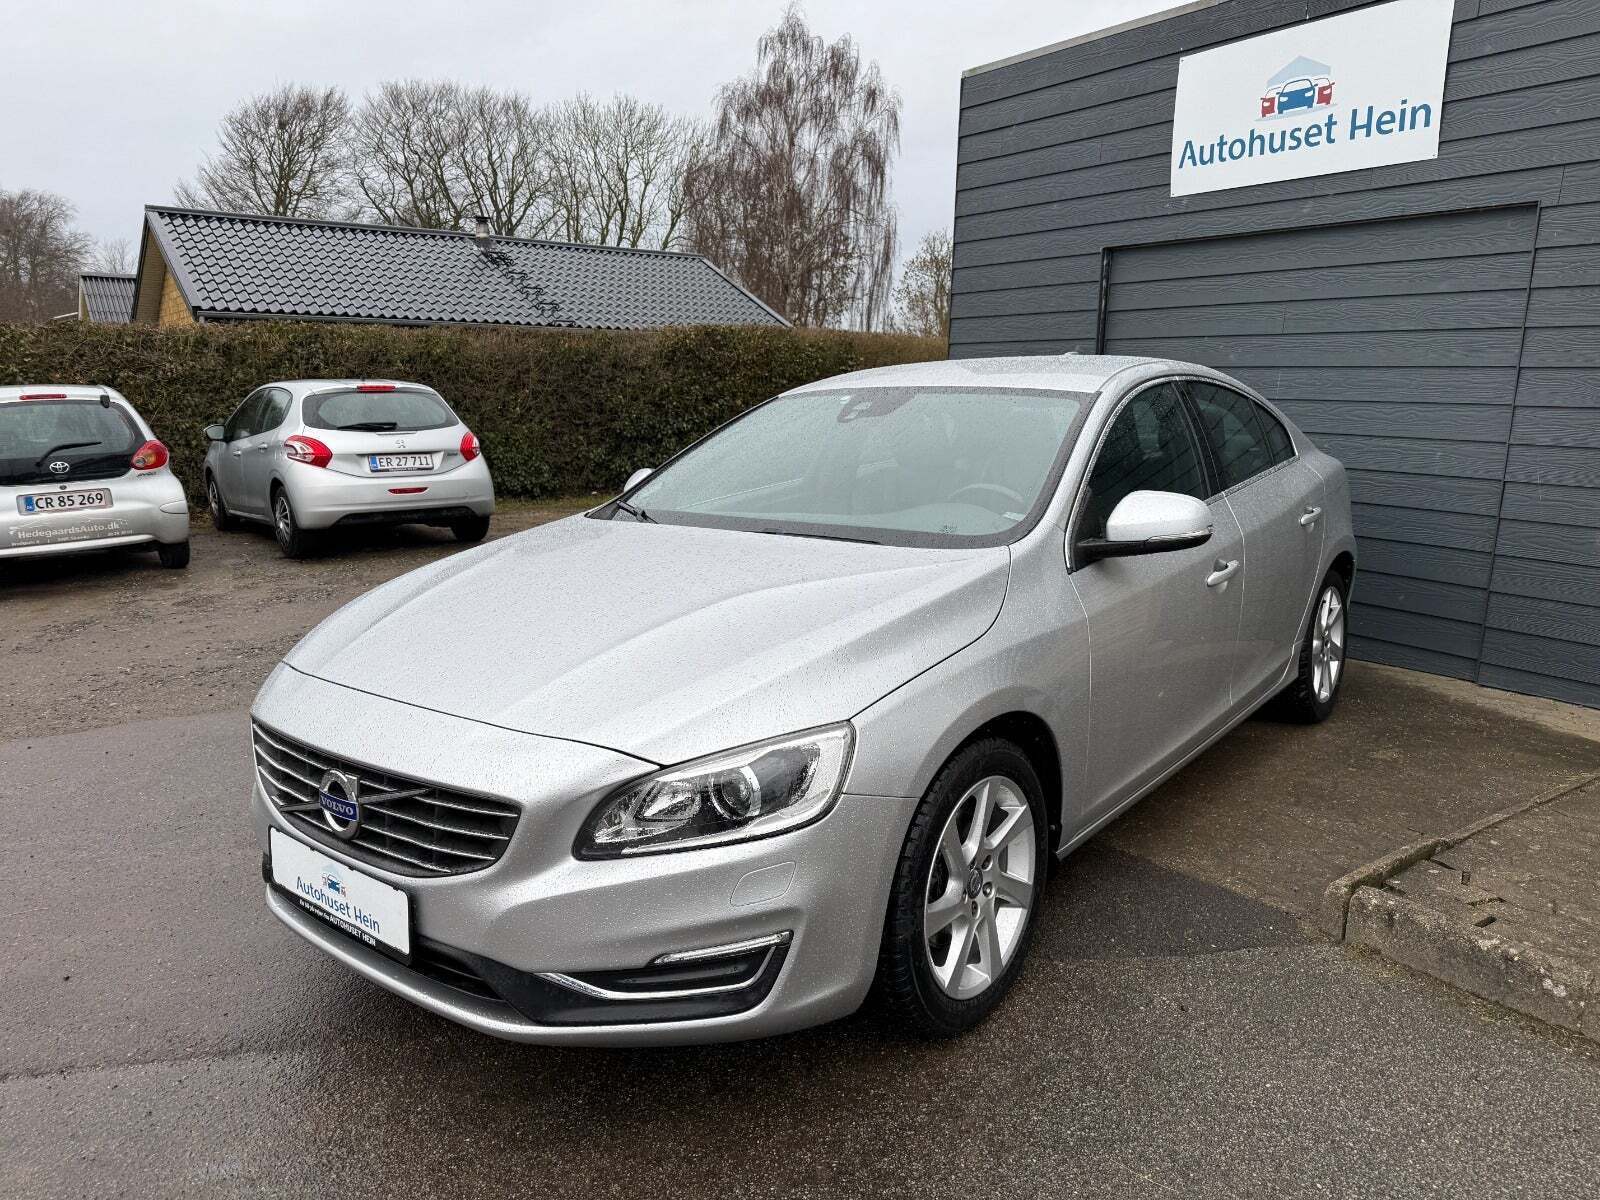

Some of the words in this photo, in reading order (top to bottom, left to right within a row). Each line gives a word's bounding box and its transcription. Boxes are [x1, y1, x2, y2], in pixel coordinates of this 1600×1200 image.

[1178, 113, 1338, 169] Autohuset
[1349, 98, 1432, 141] Hein
[379, 457, 393, 467] ER
[395, 456, 408, 467] 27
[410, 455, 430, 466] 711
[35, 497, 54, 509] CR
[58, 495, 75, 508] 85
[79, 492, 103, 506] 269
[17, 521, 120, 539] HedegaardsAuto.dk
[320, 795, 354, 816] VOLVO
[296, 876, 351, 918] Autohuset
[353, 905, 380, 934] Hein
[330, 914, 361, 937] AUTOHUSET
[362, 932, 376, 947] HEIN
